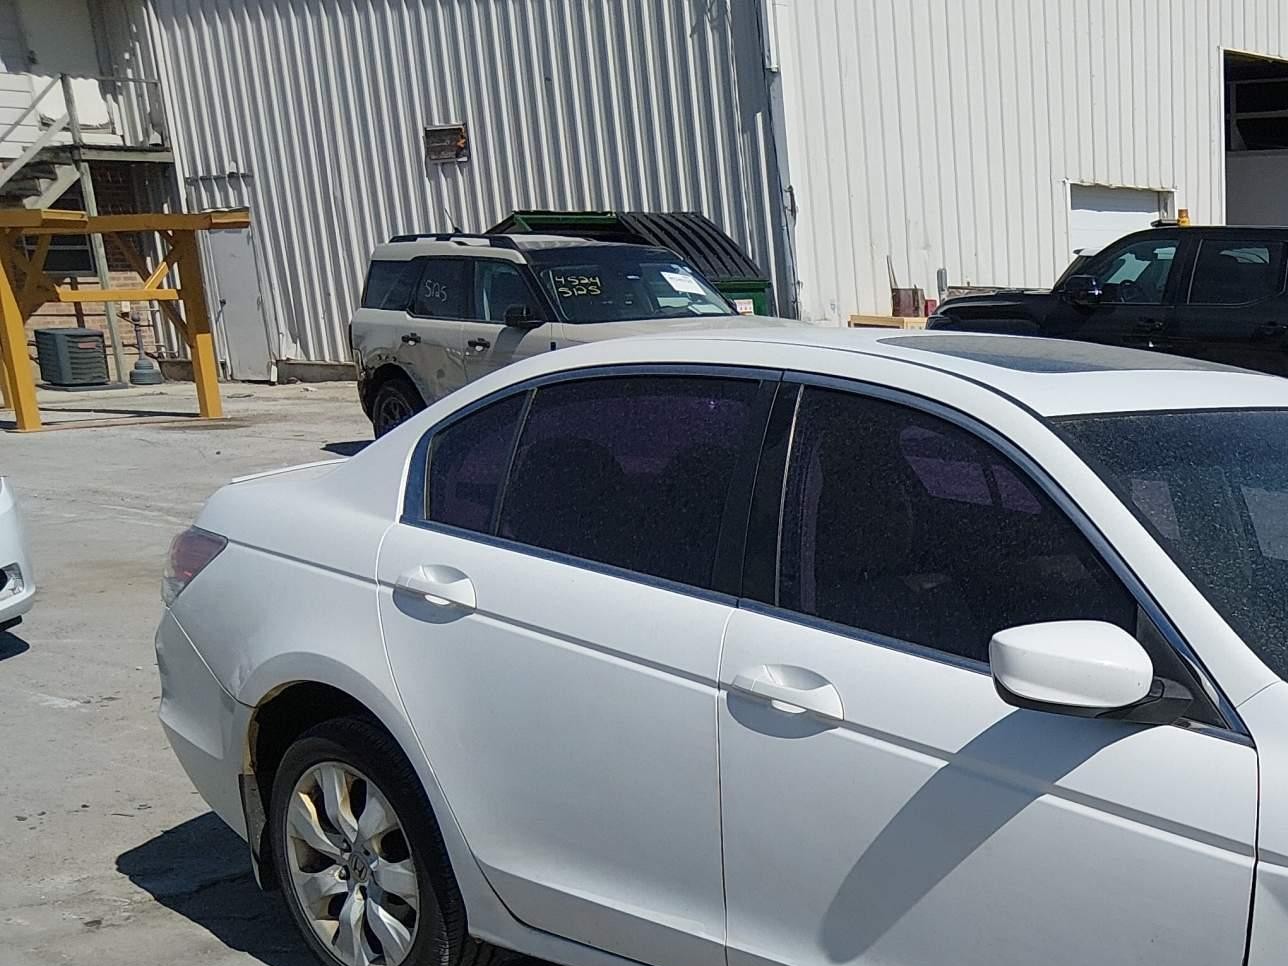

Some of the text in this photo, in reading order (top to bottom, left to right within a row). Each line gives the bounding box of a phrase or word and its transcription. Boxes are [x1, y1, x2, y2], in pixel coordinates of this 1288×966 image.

[555, 275, 601, 286] 4524
[425, 279, 448, 302] 5125
[558, 285, 601, 297] 5125
